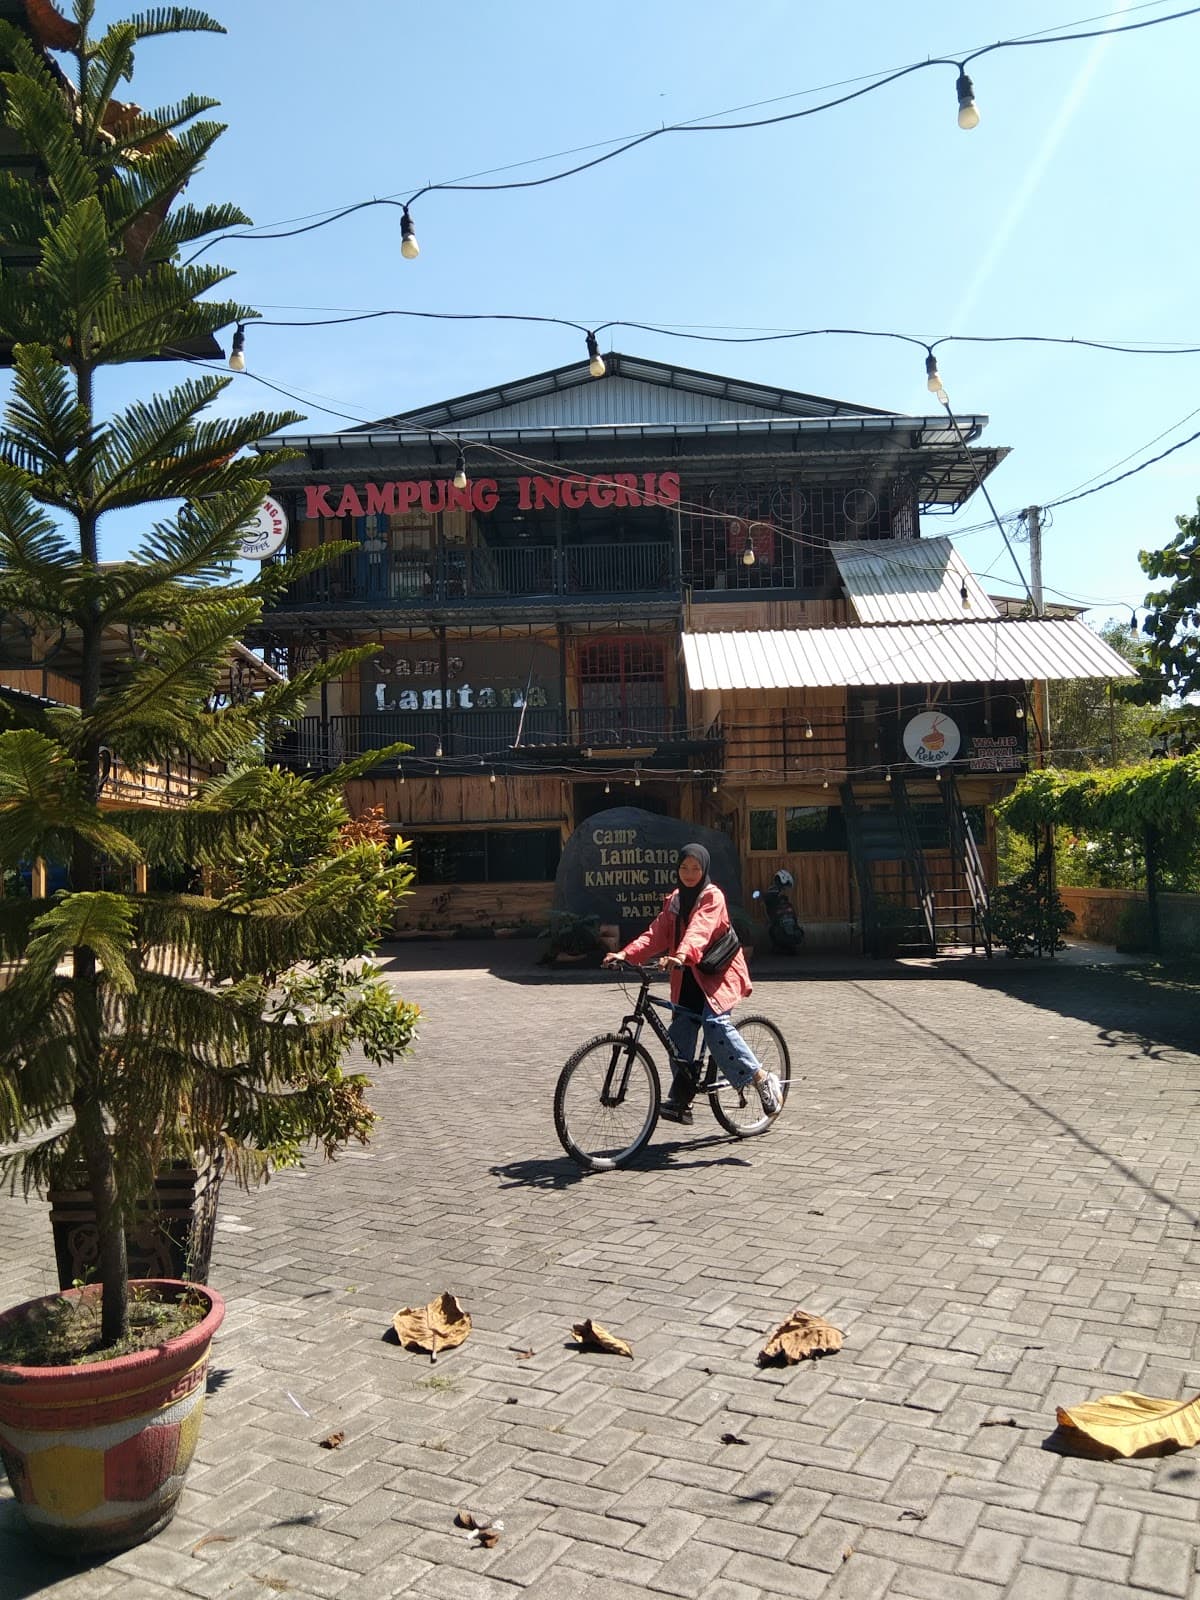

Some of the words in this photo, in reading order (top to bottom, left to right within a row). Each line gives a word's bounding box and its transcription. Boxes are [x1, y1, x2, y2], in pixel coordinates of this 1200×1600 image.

[304, 480, 498, 518] KAMPUNG
[518, 472, 681, 510] INGGRIS
[972, 736, 1017, 747] WAJIB
[593, 829, 637, 845] Camp
[585, 870, 650, 887] KAMPUNG
